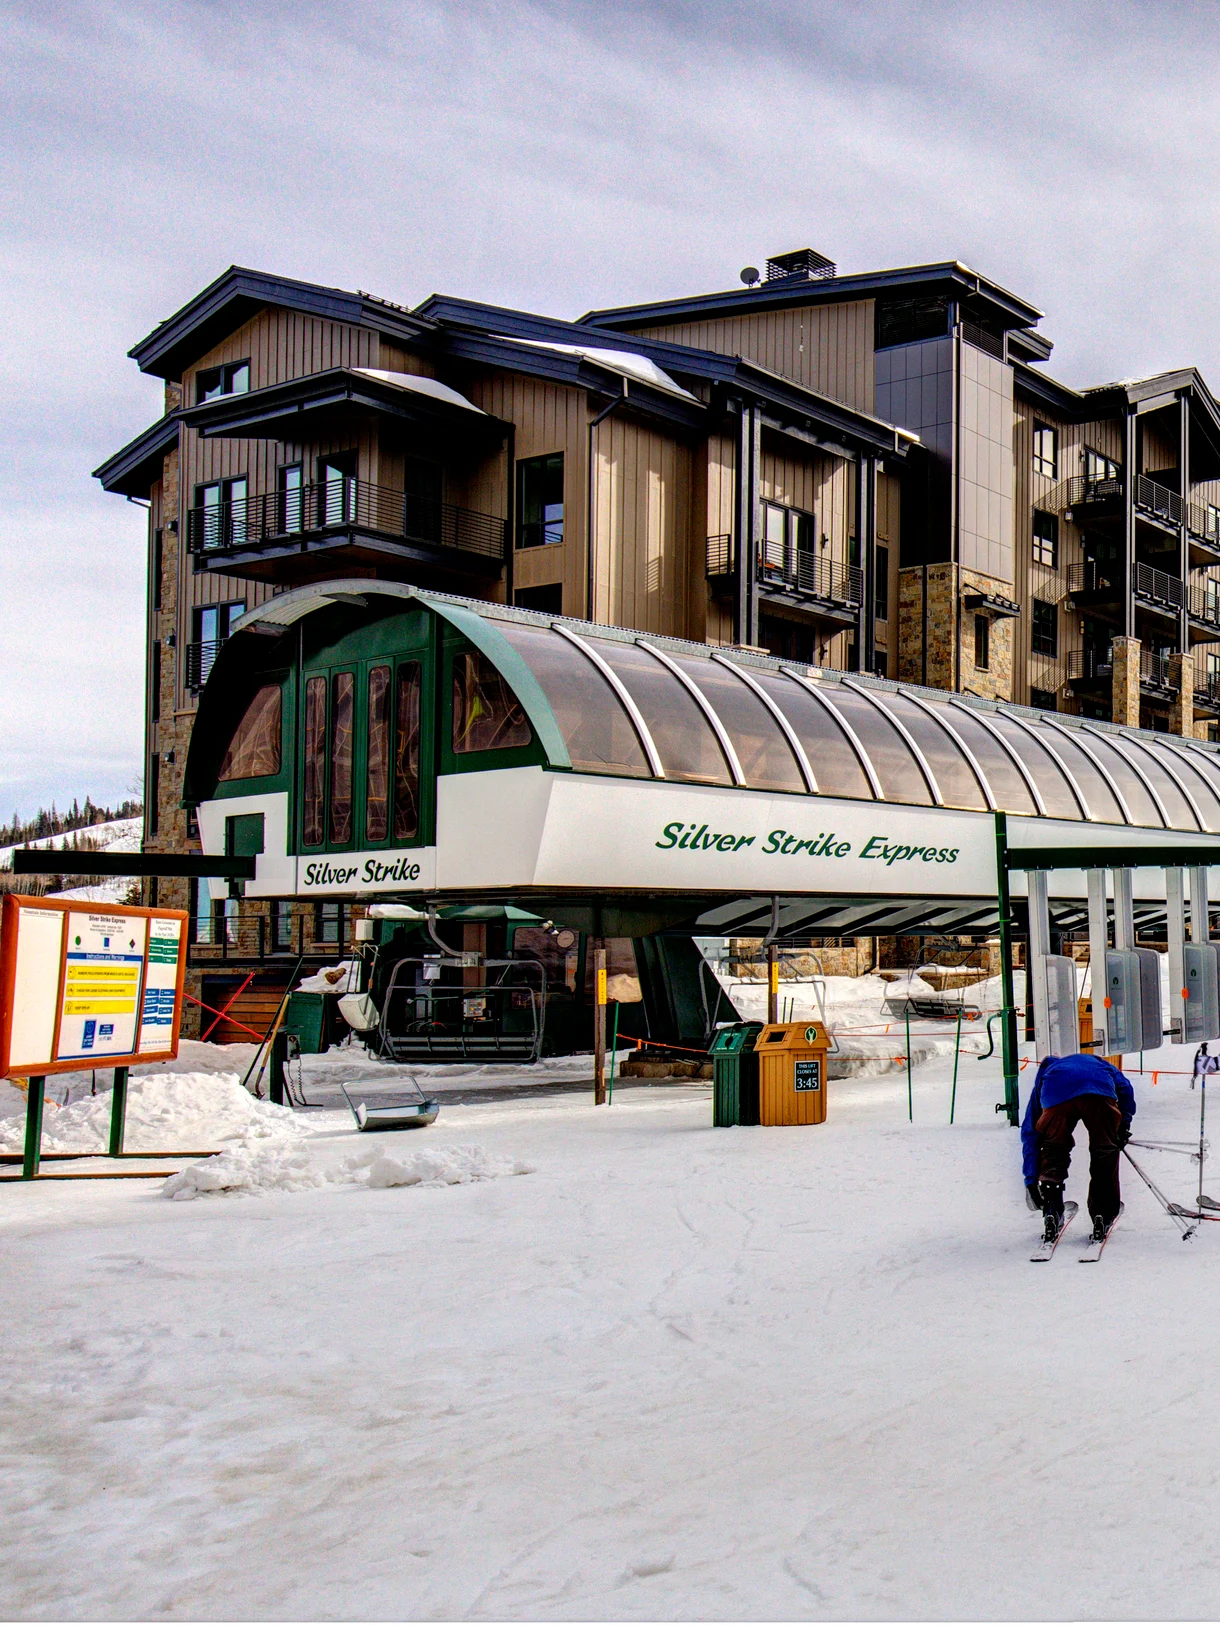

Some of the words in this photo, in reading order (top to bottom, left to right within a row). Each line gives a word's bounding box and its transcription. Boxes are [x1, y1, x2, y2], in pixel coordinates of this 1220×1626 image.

[655, 822, 756, 852] Silver
[762, 829, 851, 858] Strike
[858, 835, 960, 866] Express
[304, 862, 358, 886] Silver
[362, 858, 420, 883] Strike
[797, 1077, 818, 1089] 3:45
